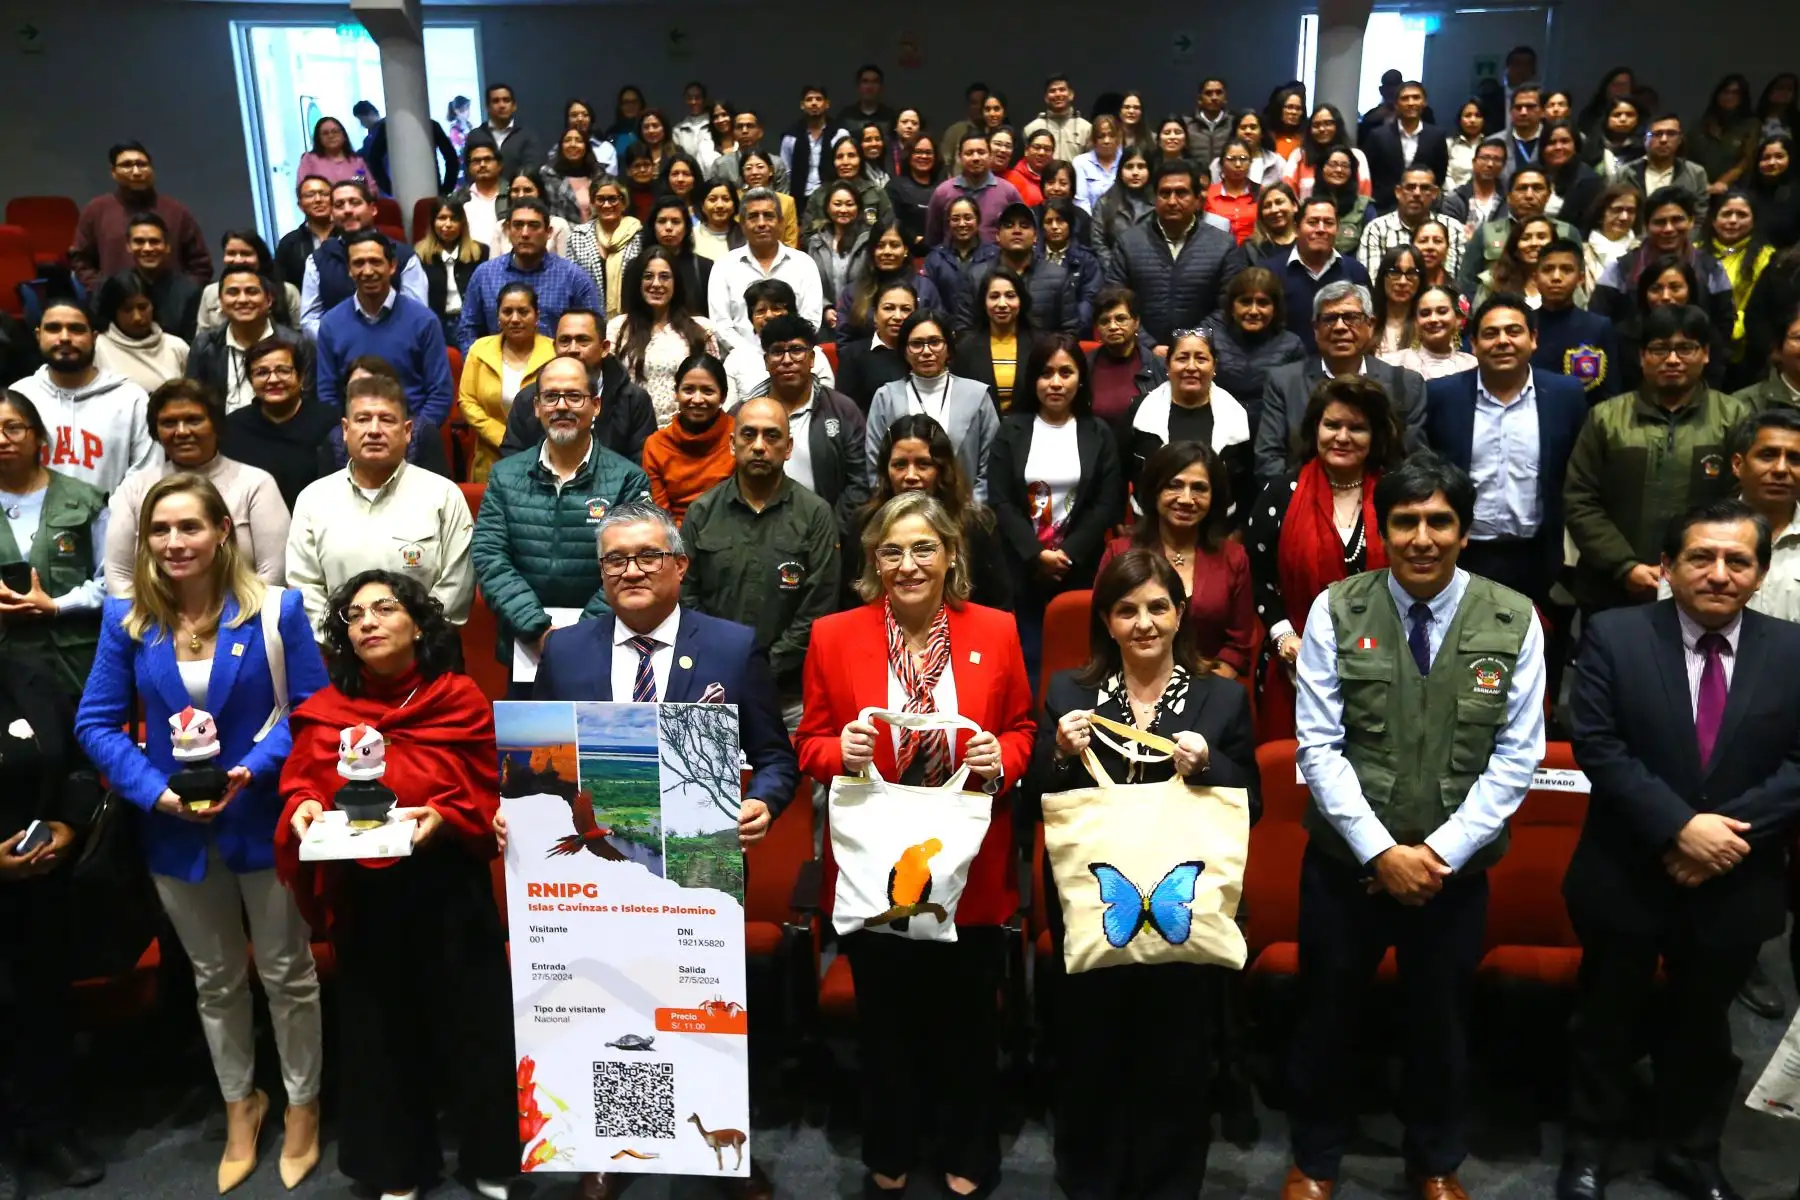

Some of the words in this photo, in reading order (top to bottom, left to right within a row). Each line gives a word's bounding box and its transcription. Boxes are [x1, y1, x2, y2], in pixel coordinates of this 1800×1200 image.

[1534, 778, 1575, 787] SERVADO
[527, 882, 599, 899] RNIPG
[528, 903, 554, 912] Islas
[557, 903, 608, 912] Cavinzas
[621, 904, 659, 914] Islotes
[662, 905, 716, 915] Palomino
[529, 925, 568, 933] Visitante
[677, 928, 694, 936] DNI
[529, 935, 545, 943] 001
[678, 938, 725, 948] 1921X5820
[531, 962, 566, 971] Entrada
[678, 965, 706, 974] Salida
[532, 972, 573, 981] 27/5/2024
[679, 976, 720, 985] 27/5/2024
[534, 1005, 554, 1014] Tipo
[555, 1005, 567, 1013] de
[568, 1005, 606, 1014] visitante
[534, 1015, 571, 1023] Nacional
[671, 1012, 698, 1021] Precio
